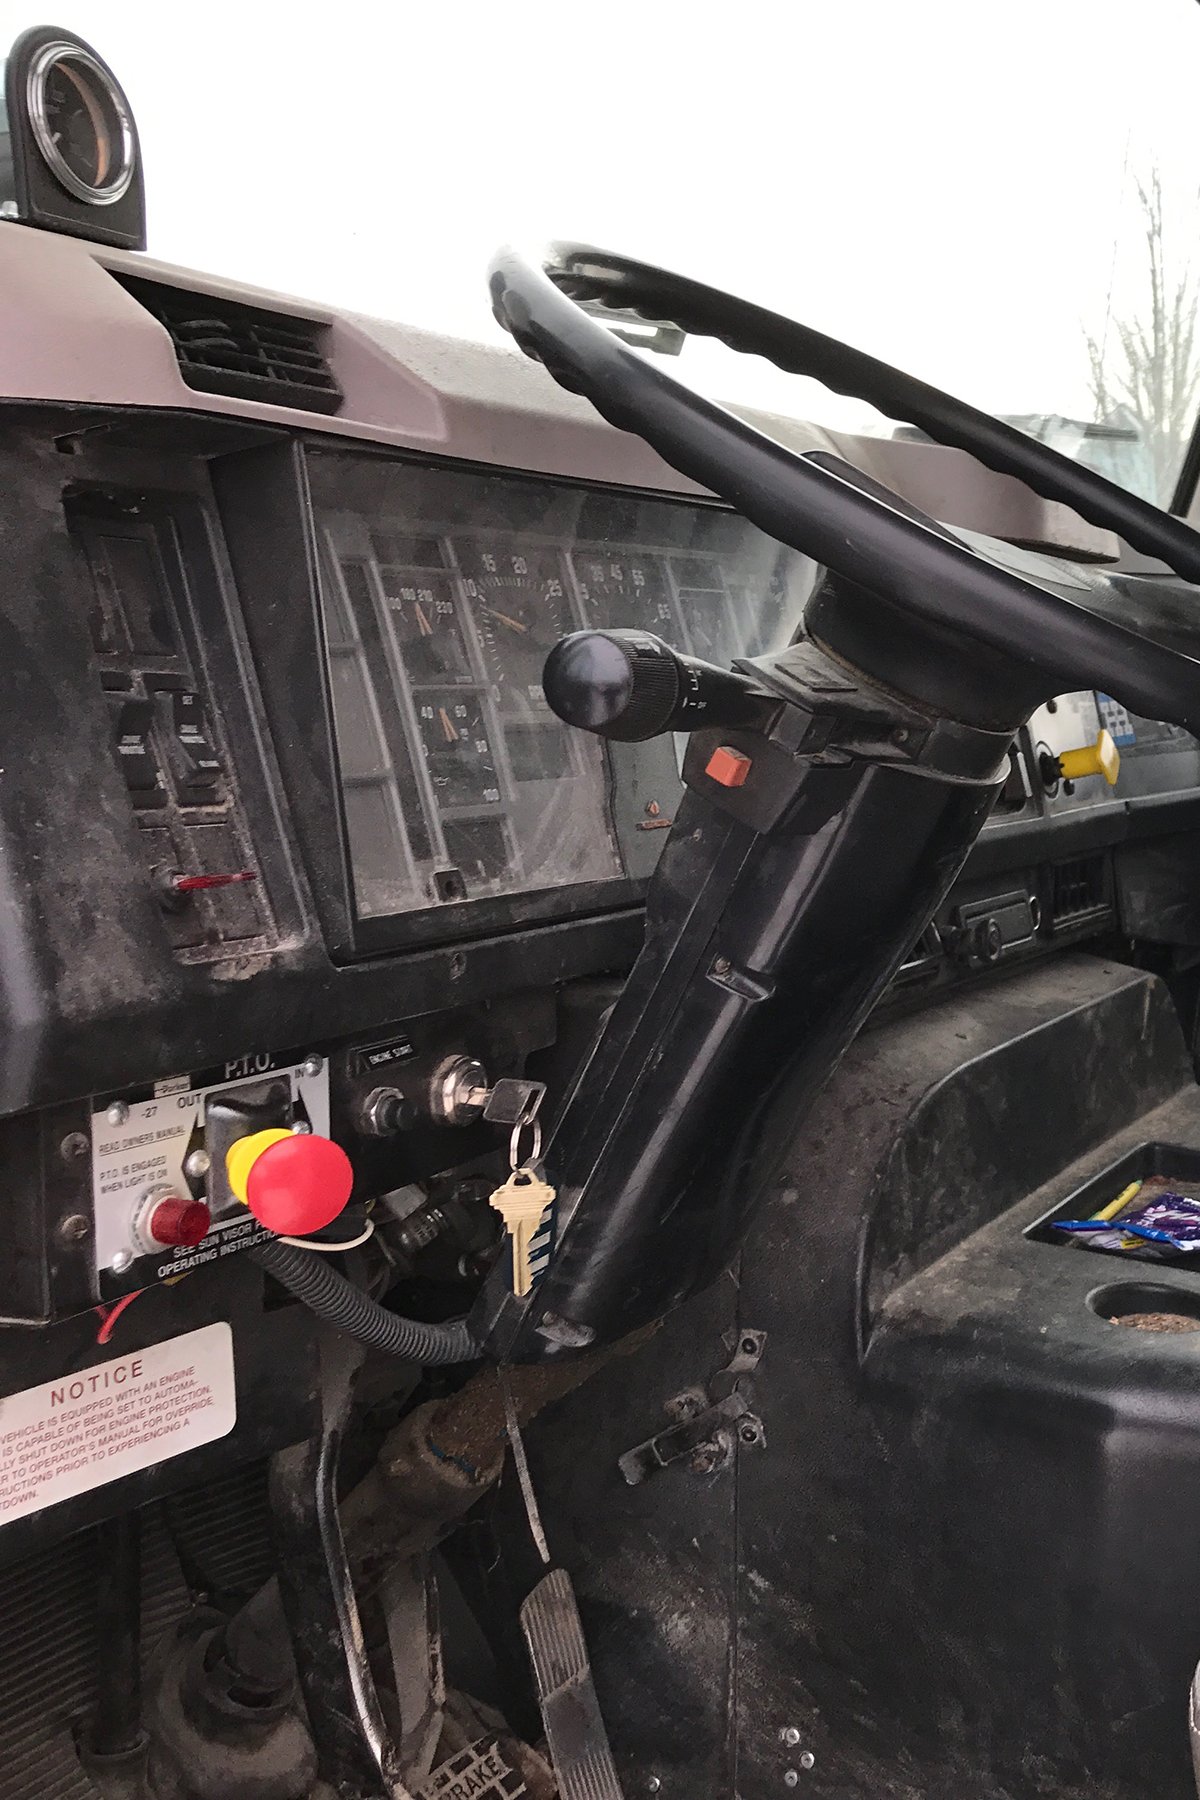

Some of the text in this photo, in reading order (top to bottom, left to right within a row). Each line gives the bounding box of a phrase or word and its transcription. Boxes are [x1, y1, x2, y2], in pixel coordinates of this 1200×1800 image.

[176, 1092, 202, 1109] OUT
[157, 1230, 278, 1277] OPERATING INSTRUCTIO
[198, 1233, 220, 1250] SUN
[222, 1222, 252, 1241] VISOR
[0, 1366, 195, 1444] VEHICLE IS EQUIPPED WITH AN ENGINE
[50, 1359, 144, 1407] NOTICE
[3, 1446, 13, 1457] IS
[16, 1427, 64, 1452] CAPABLE
[66, 1421, 81, 1433] OF
[84, 1409, 114, 1427] BEING
[117, 1400, 135, 1415] SET
[139, 1395, 152, 1407] TO
[12, 1468, 26, 1479] TO
[29, 1441, 96, 1473] OPERATOR'S
[98, 1426, 141, 1446] MANUAL
[142, 1416, 163, 1430] FOR
[165, 1396, 214, 1421] OVERRIDE
[19, 1446, 48, 1465] SHUT
[50, 1433, 84, 1453] DOWN
[85, 1425, 106, 1439] FOR
[109, 1409, 146, 1430] ENGINE
[56, 1457, 89, 1475] PRIOR
[92, 1450, 105, 1462] TO
[108, 1421, 181, 1456] EXPERIENCING
[183, 1418, 190, 1427] A
